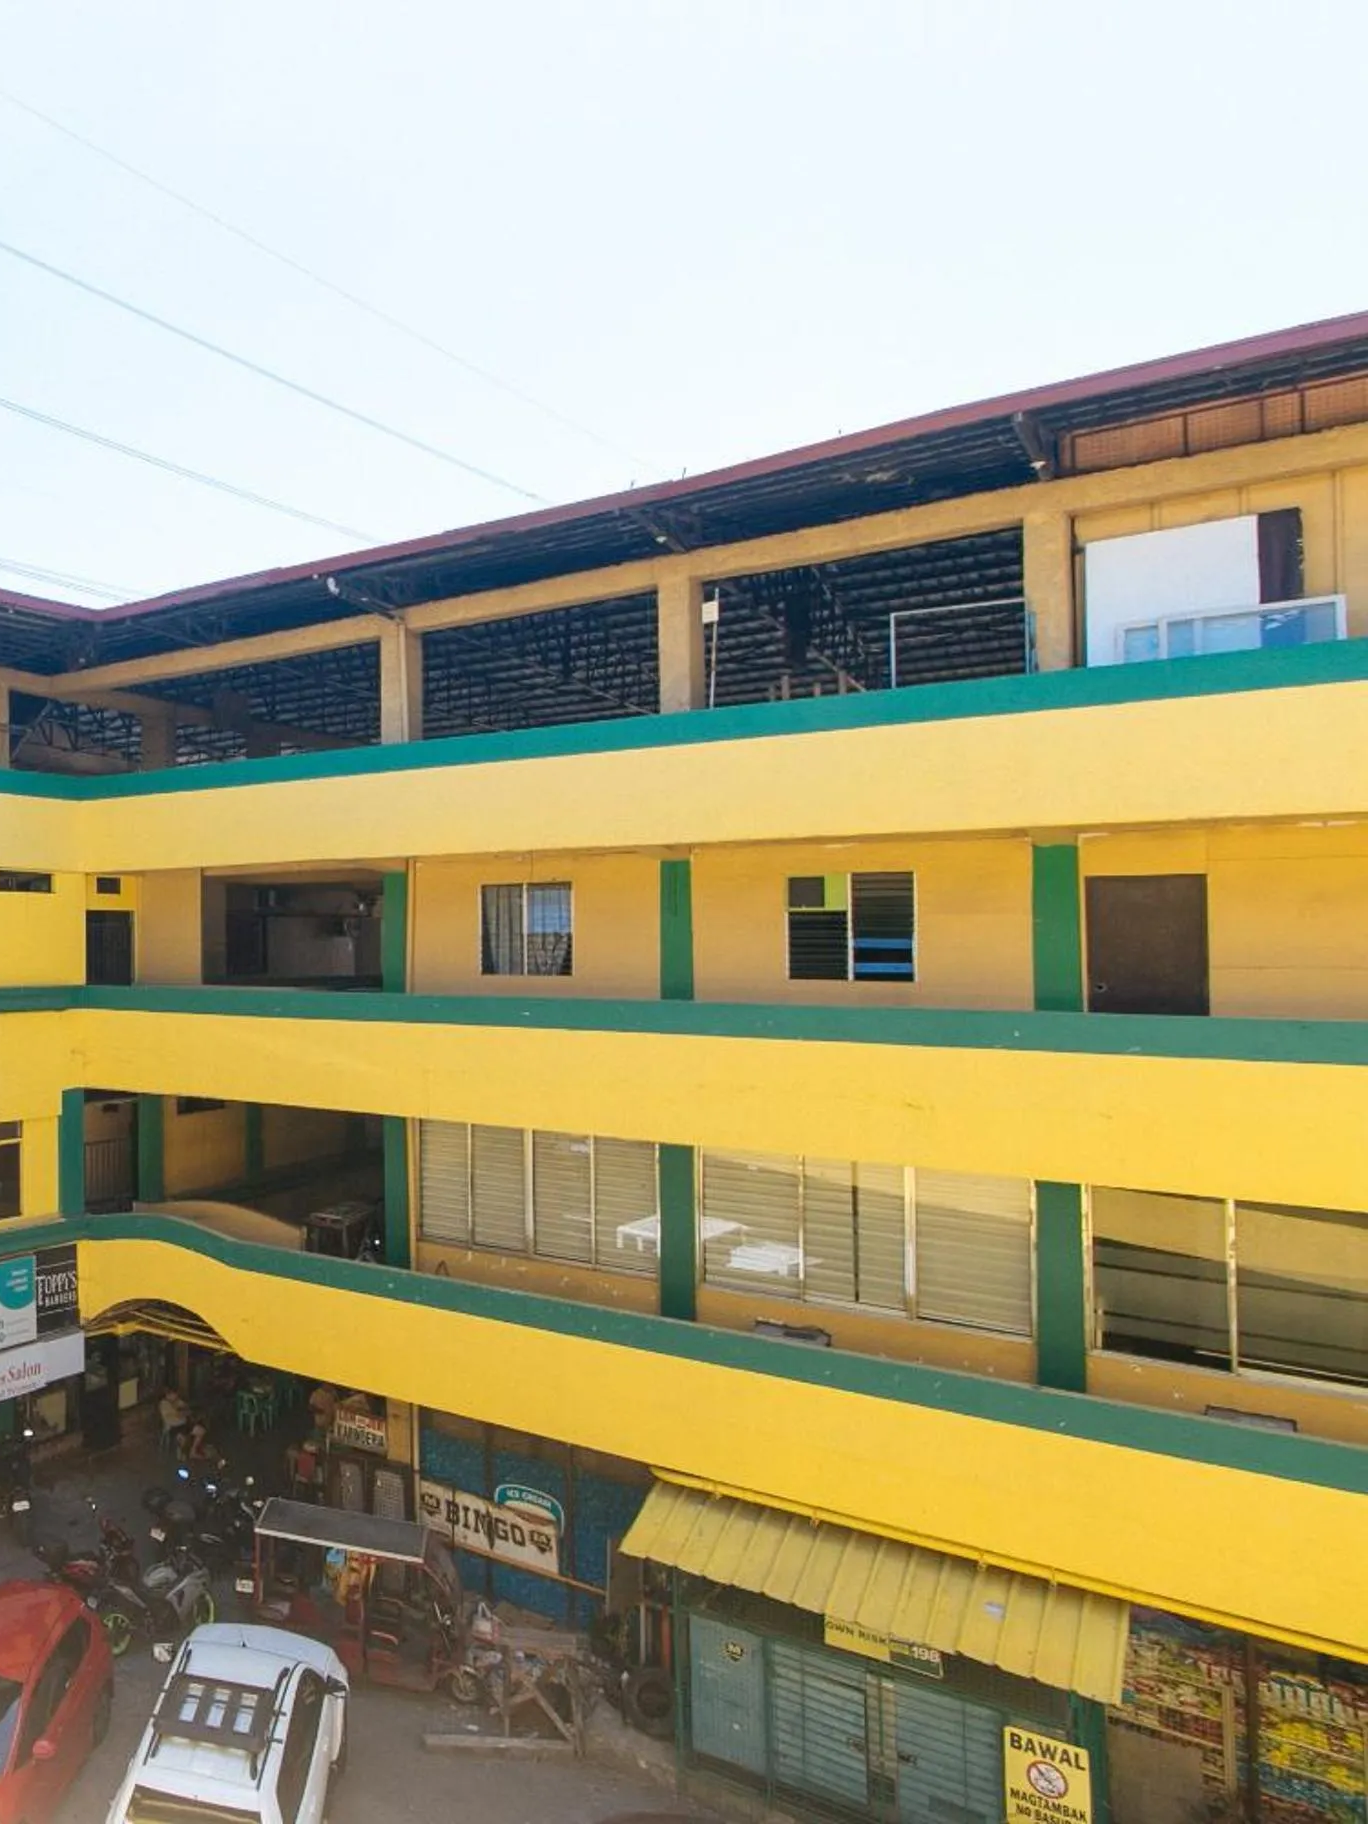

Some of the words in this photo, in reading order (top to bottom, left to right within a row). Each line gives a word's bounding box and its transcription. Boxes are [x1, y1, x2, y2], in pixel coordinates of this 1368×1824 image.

[445, 1498, 526, 1547] BINGO
[1009, 1732, 1086, 1771] BAWAL
[1009, 1787, 1088, 1823] MAGTAMBAK
